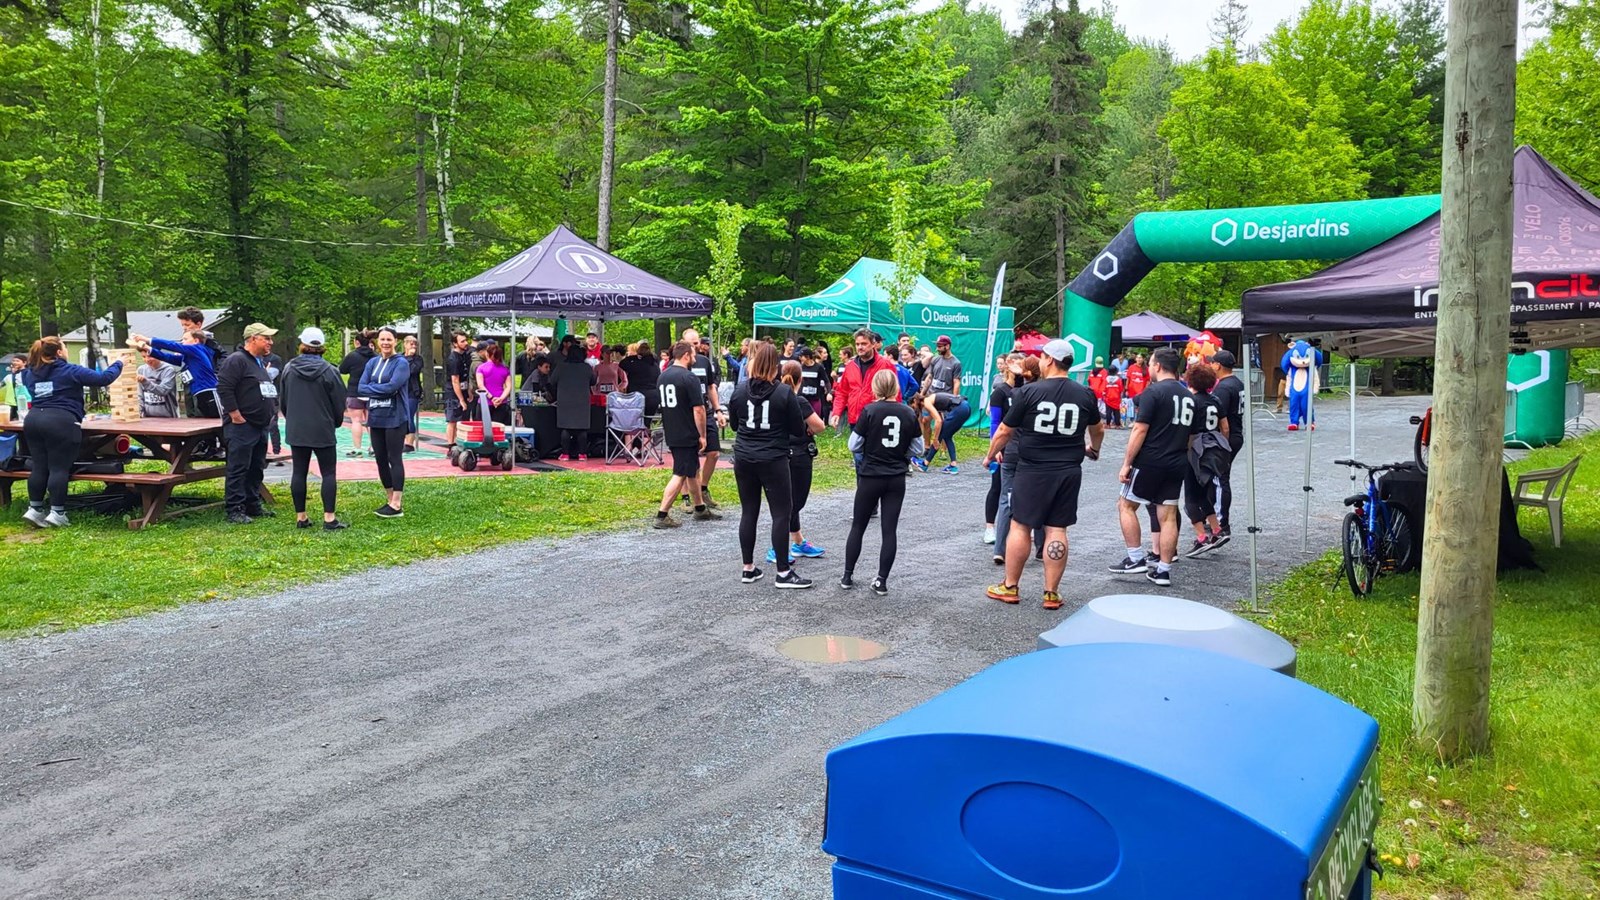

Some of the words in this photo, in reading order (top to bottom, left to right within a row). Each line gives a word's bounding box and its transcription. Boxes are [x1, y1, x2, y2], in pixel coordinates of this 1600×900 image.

[1243, 218, 1350, 243] Desjardins
[569, 252, 608, 274] D
[577, 281, 638, 291] DUQUET
[422, 292, 506, 309] www.metalduquet.com
[522, 292, 544, 305] LA
[548, 293, 635, 307] PUISSANCE
[639, 296, 659, 308] DE
[662, 297, 706, 310] L'INOX
[795, 306, 838, 318] Desjardins
[1510, 302, 1575, 313] ÉPASSEMENT
[933, 311, 970, 324] Desjardins
[961, 370, 983, 387] dins
[659, 384, 678, 408] 18
[746, 399, 771, 430] 11
[1034, 401, 1080, 436] 20
[1172, 395, 1195, 427] 16
[1205, 405, 1219, 431] 6
[881, 415, 901, 448] 3
[1328, 775, 1374, 900] RECYCLAGE
